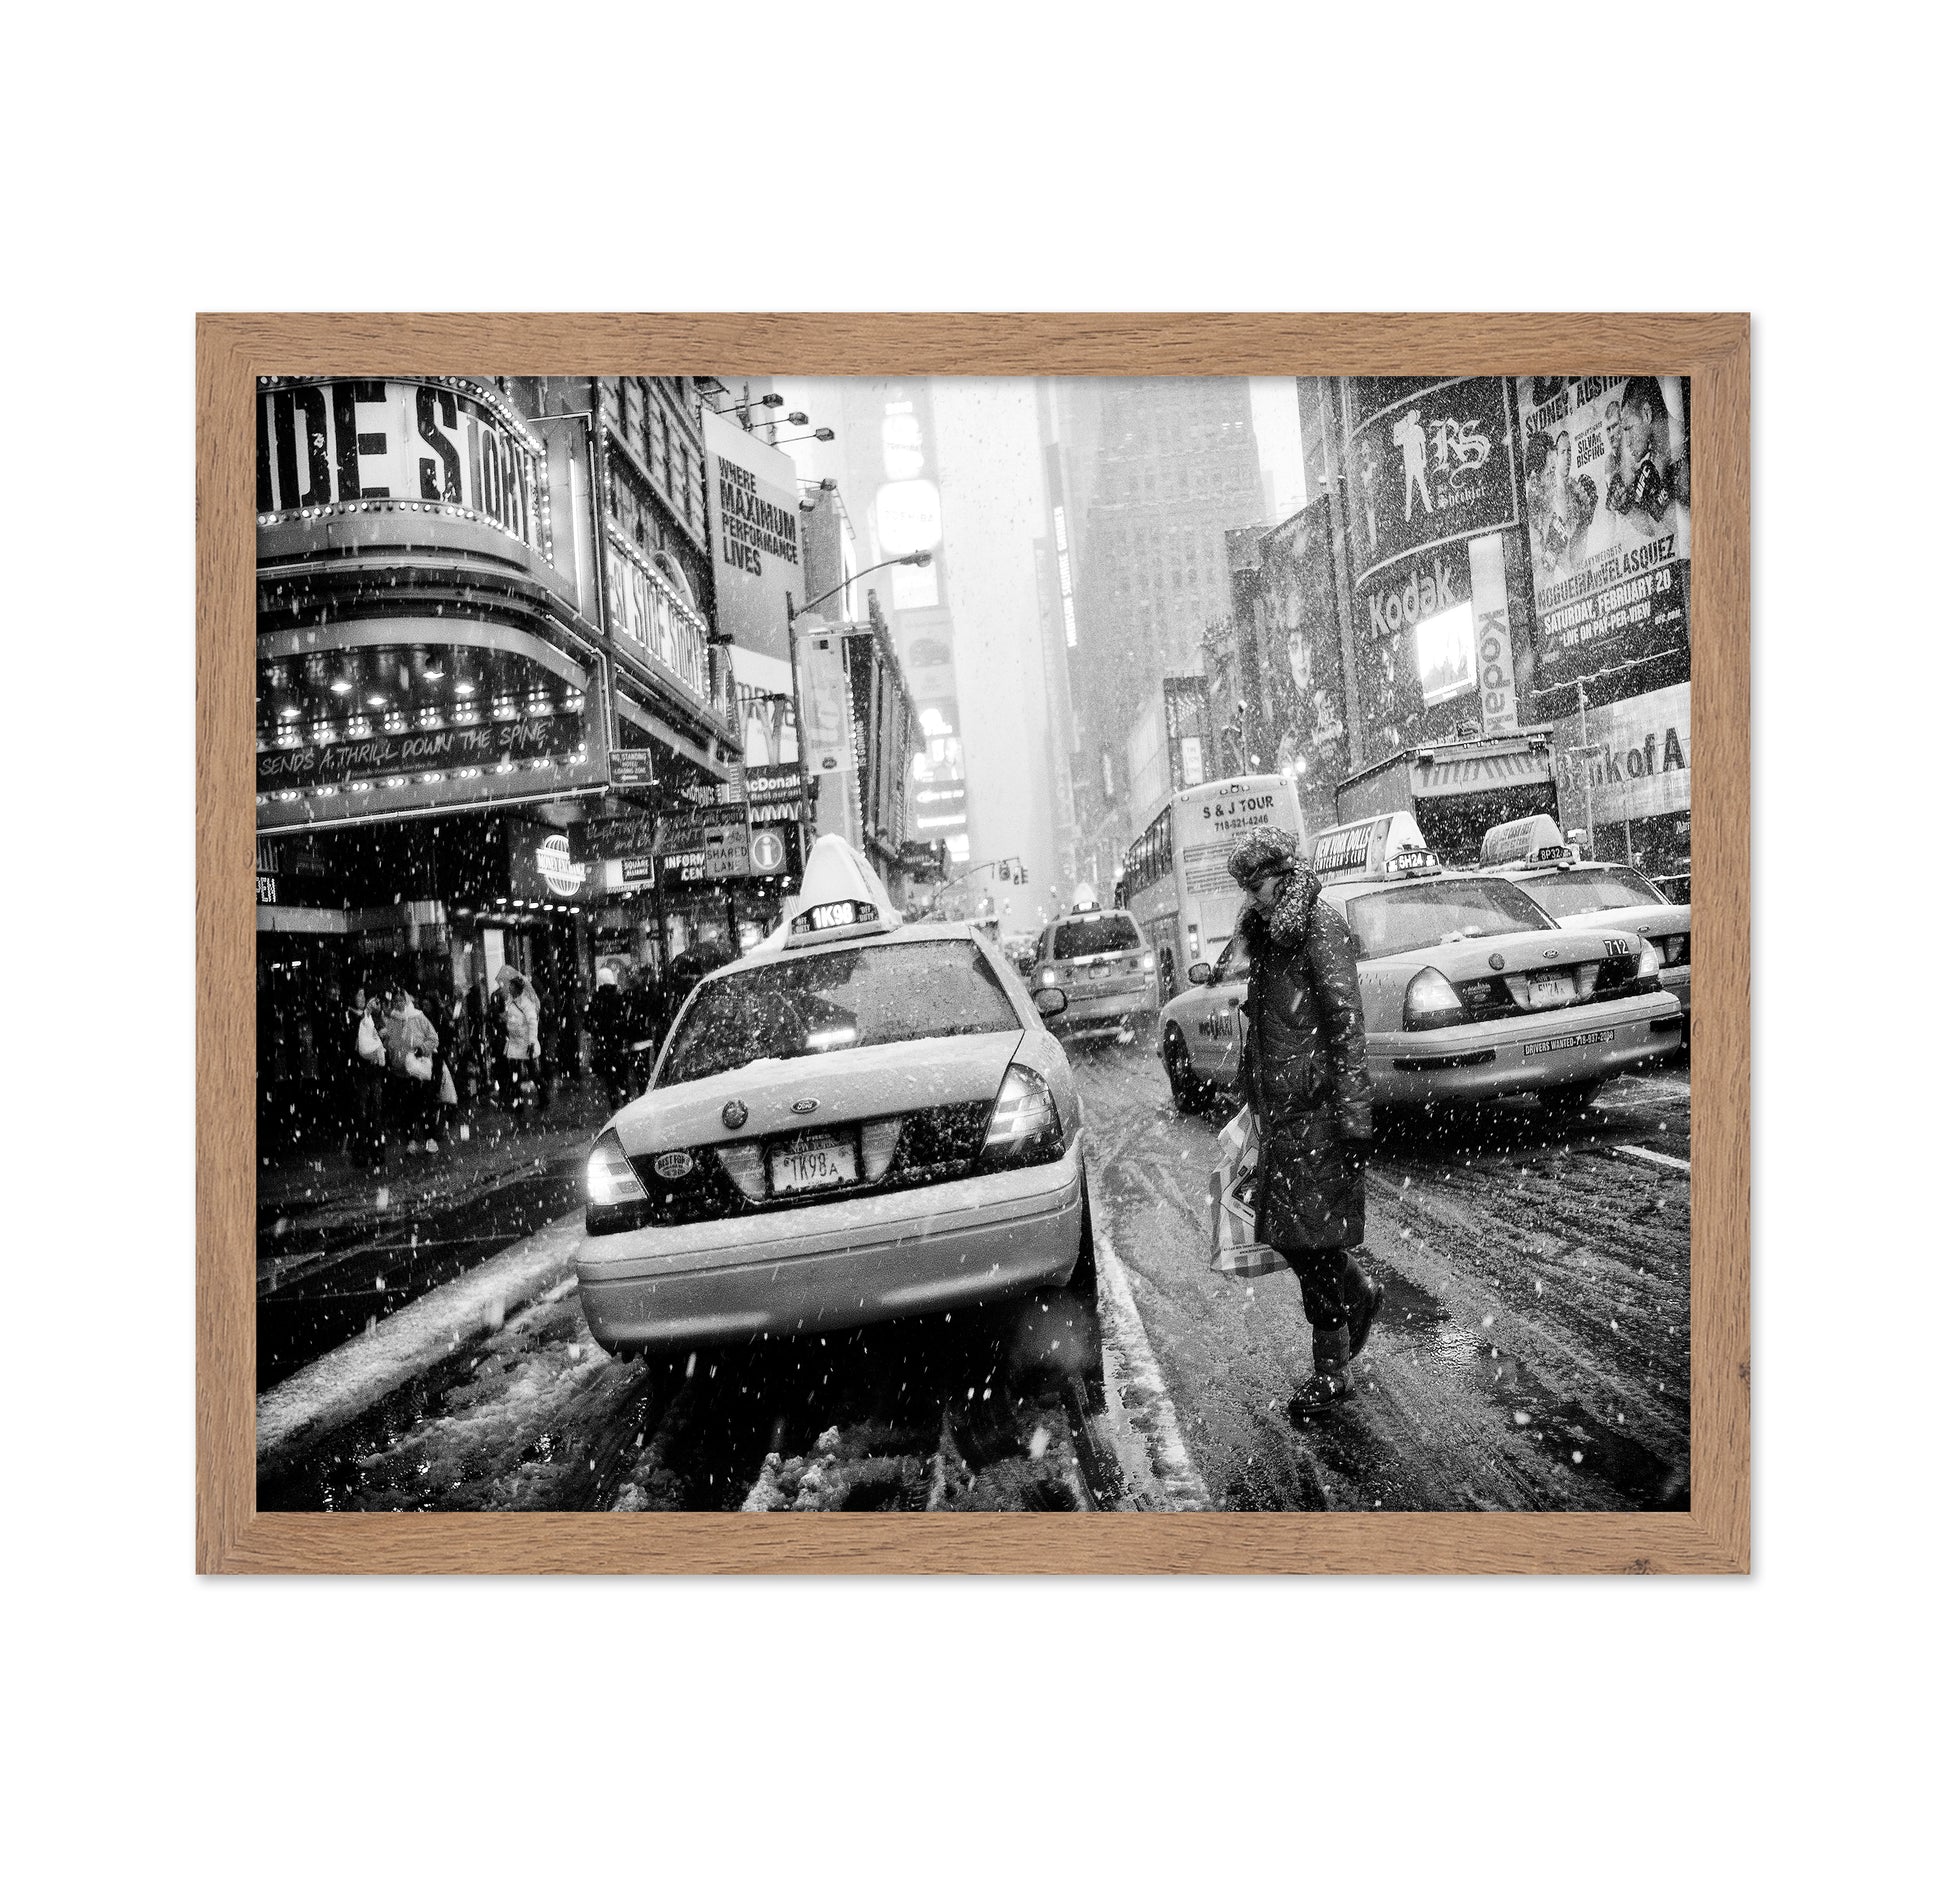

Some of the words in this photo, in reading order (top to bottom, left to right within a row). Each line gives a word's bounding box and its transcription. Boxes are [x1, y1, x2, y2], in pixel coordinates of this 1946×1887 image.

[718, 455, 757, 495] WHERE
[719, 478, 796, 544] MAXIMUM
[722, 511, 799, 565] PERFORMANCE
[723, 535, 762, 576] LIVES
[1600, 534, 1675, 584] VELASQUEZ
[1368, 558, 1455, 639] Kodak
[1597, 574, 1653, 616] FEBRUARY
[1655, 568, 1671, 594] 20
[1580, 624, 1592, 641] ON
[1478, 608, 1514, 732] Kodak
[259, 750, 314, 776] SENDS
[337, 742, 399, 767] THRILL
[402, 733, 453, 759] DOWN
[460, 728, 492, 750] THE
[1627, 733, 1655, 778] of
[1662, 727, 1685, 772] A
[1203, 807, 1211, 819] S
[1215, 804, 1225, 817] &
[1228, 802, 1236, 815] J
[1240, 795, 1274, 812] TOUR
[707, 846, 747, 860] SHARED
[714, 861, 739, 874] LANE
[812, 902, 854, 929] 1K98
[1604, 939, 1629, 955] 712
